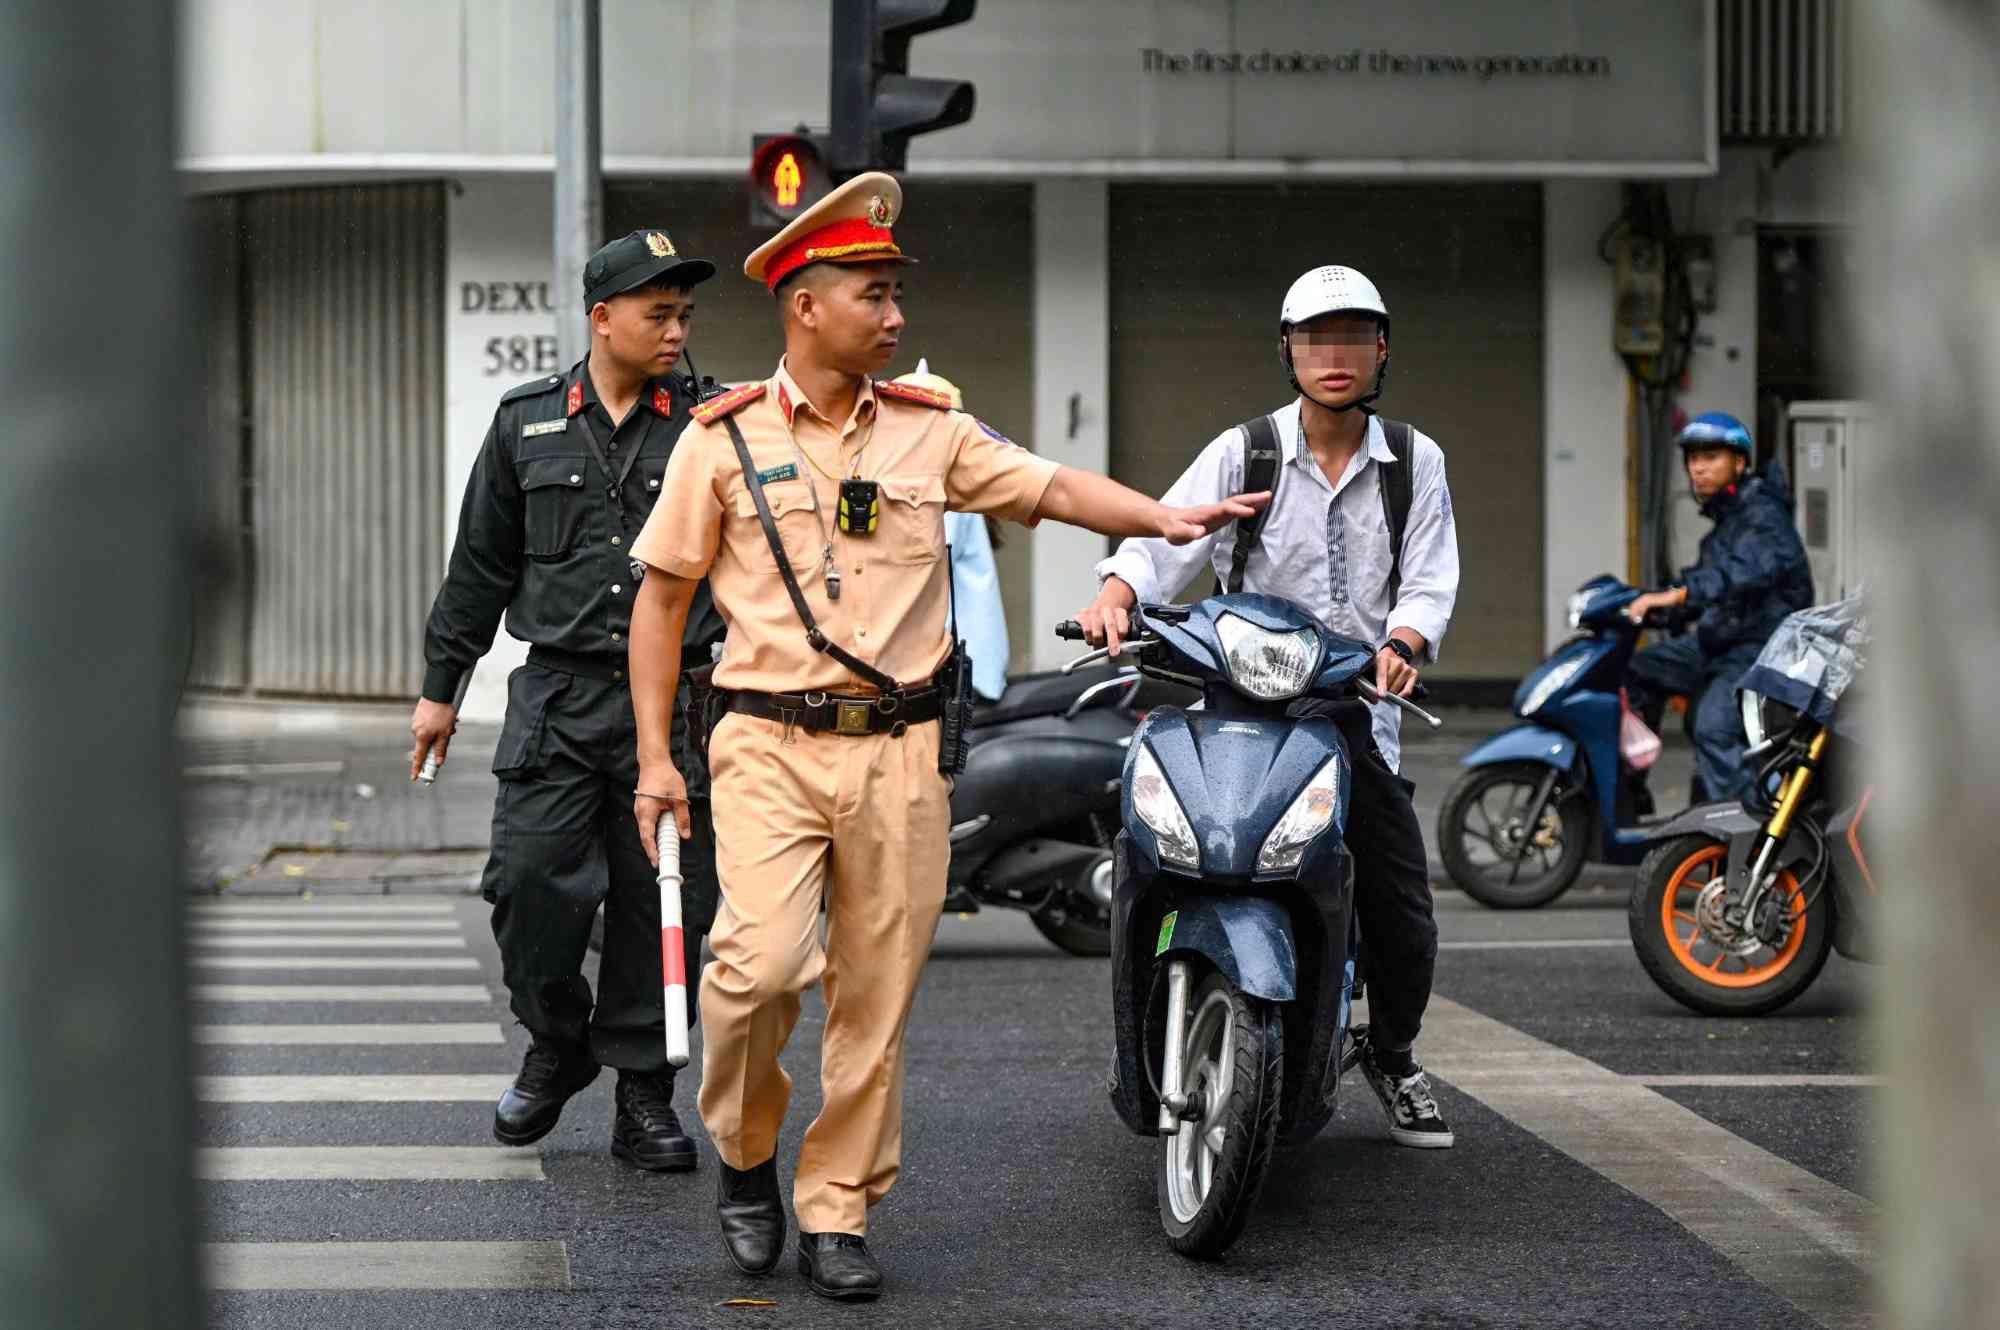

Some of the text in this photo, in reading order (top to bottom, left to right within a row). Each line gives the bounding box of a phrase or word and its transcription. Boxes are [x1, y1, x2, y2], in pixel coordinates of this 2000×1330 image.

[1139, 48, 1611, 82] The first choice of the new generation
